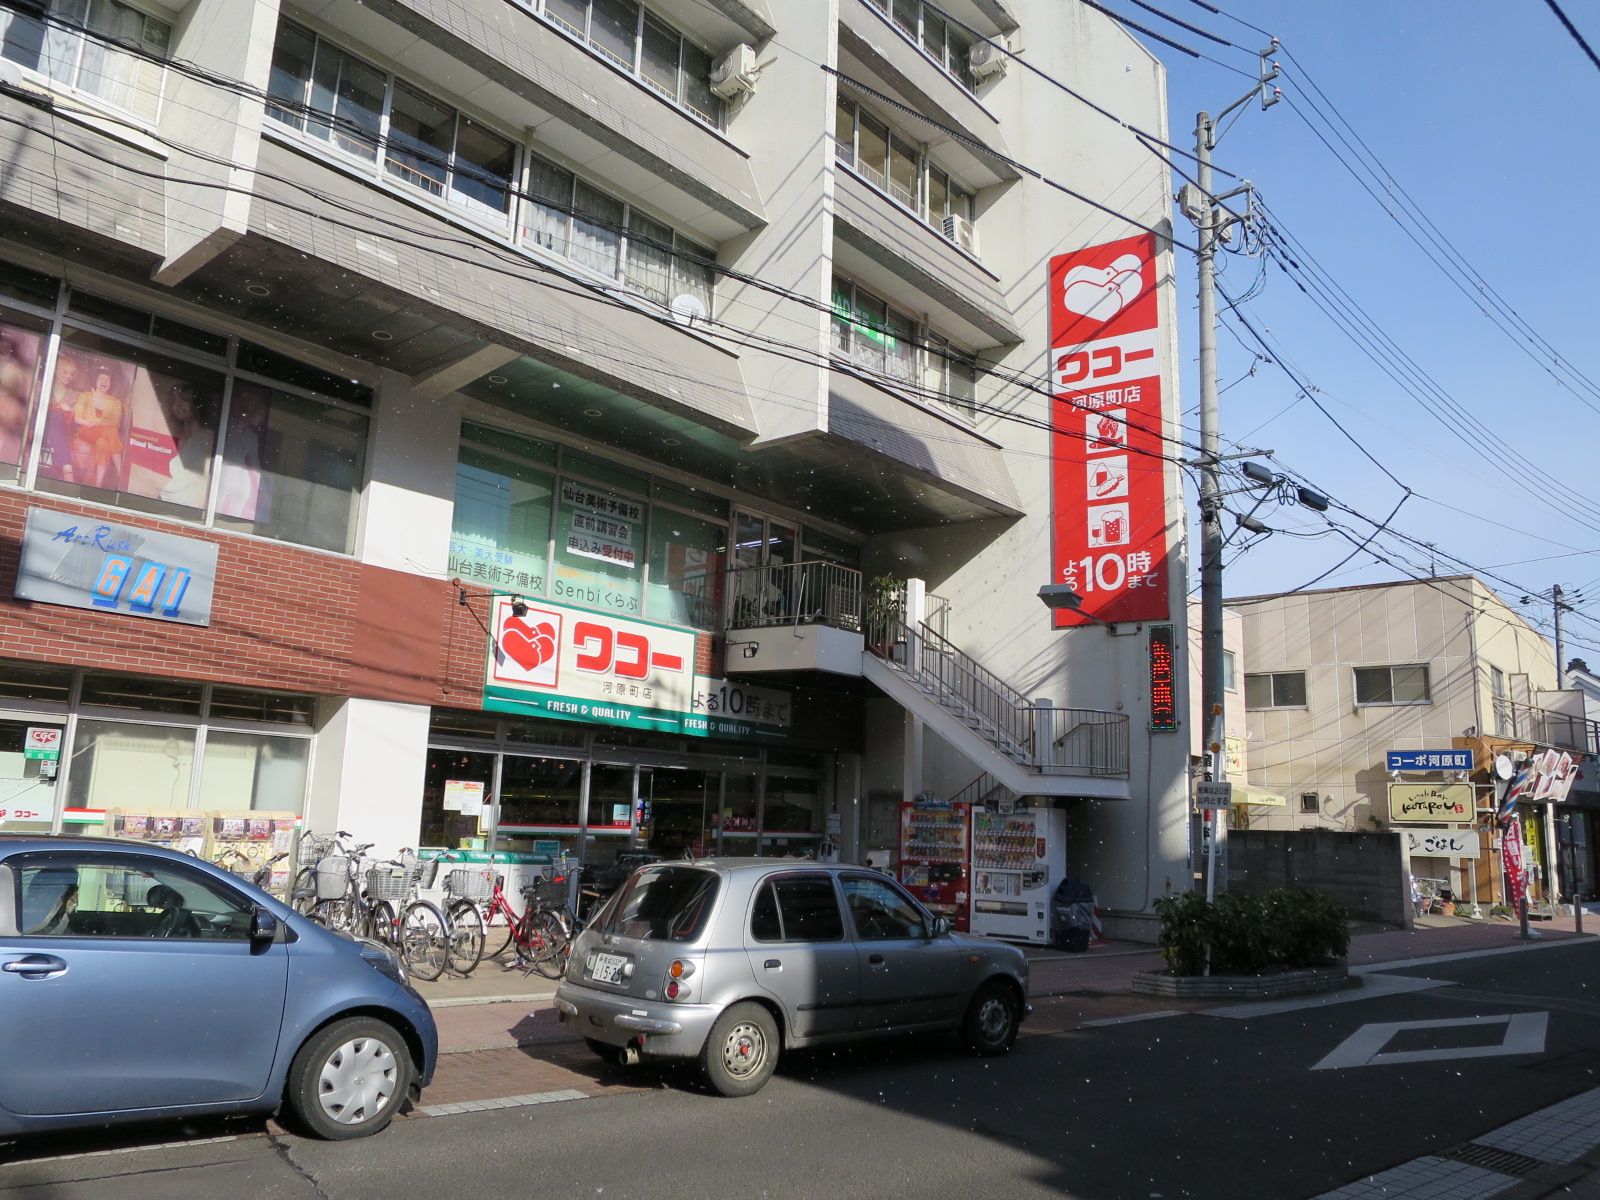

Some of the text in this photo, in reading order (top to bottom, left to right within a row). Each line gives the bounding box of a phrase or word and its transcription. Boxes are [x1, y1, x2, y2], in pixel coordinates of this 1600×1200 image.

[1057, 346, 1155, 384] ワコー
[1071, 385, 1141, 412] 河原町店
[563, 486, 639, 520] 仙台美術予備校
[574, 514, 628, 540] 直前講習会
[568, 536, 634, 563] 申込み受付中
[95, 558, 188, 608] GAI
[573, 621, 684, 681] ワコー
[602, 681, 653, 700] 河原町店
[547, 700, 631, 720] FRESH & QUALITY
[33, 731, 56, 744] CGC
[710, 721, 717, 731] &
[719, 723, 751, 735] QUALITY
[1391, 754, 1467, 767] コーポ河原町
[1425, 835, 1464, 852] ごはん
